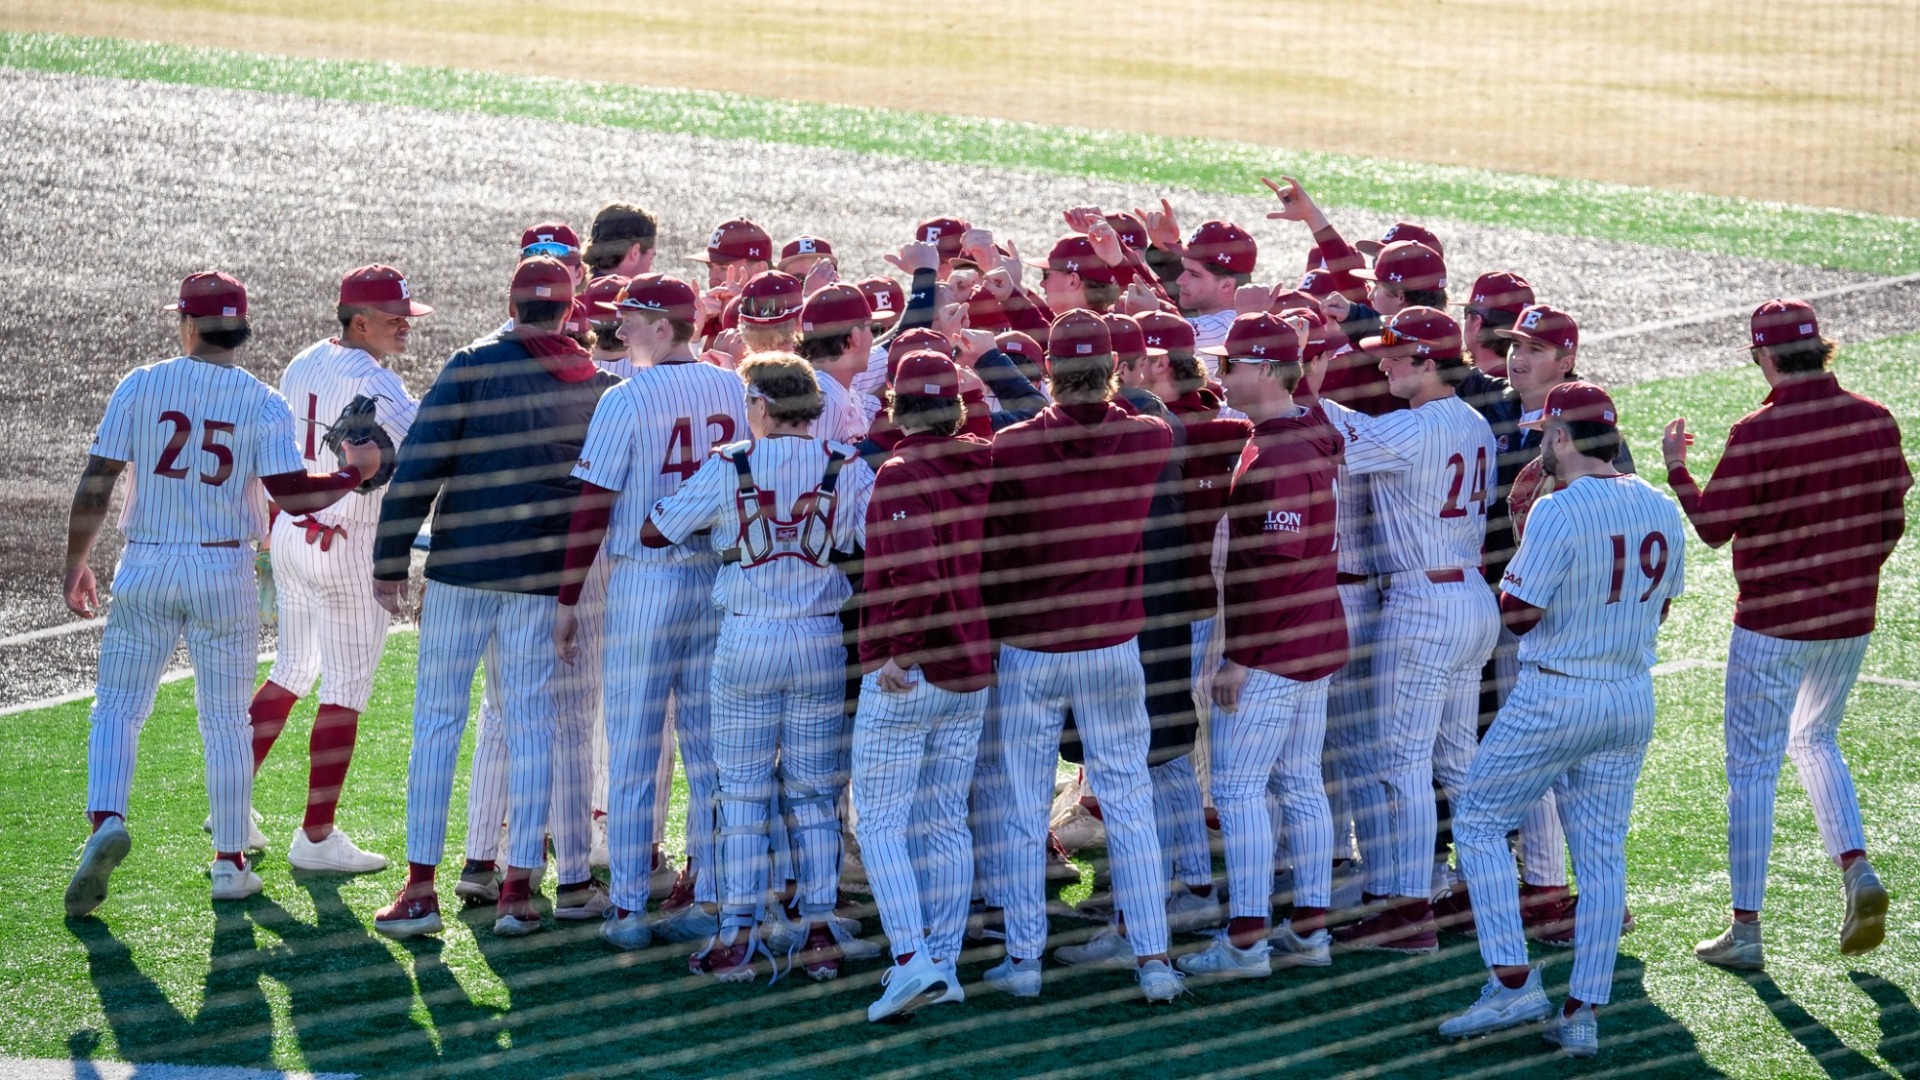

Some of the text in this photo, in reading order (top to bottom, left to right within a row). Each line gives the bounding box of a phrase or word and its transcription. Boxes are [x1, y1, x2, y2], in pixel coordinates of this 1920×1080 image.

[708, 227, 725, 249] E
[797, 237, 816, 255] E
[925, 226, 942, 246] E
[873, 290, 893, 310] E
[1521, 310, 1543, 329] E
[153, 410, 235, 487] 25
[1439, 446, 1487, 519] 24
[1264, 510, 1302, 526] LON
[1263, 523, 1301, 534] ASEBALL
[1604, 531, 1668, 605] 19
